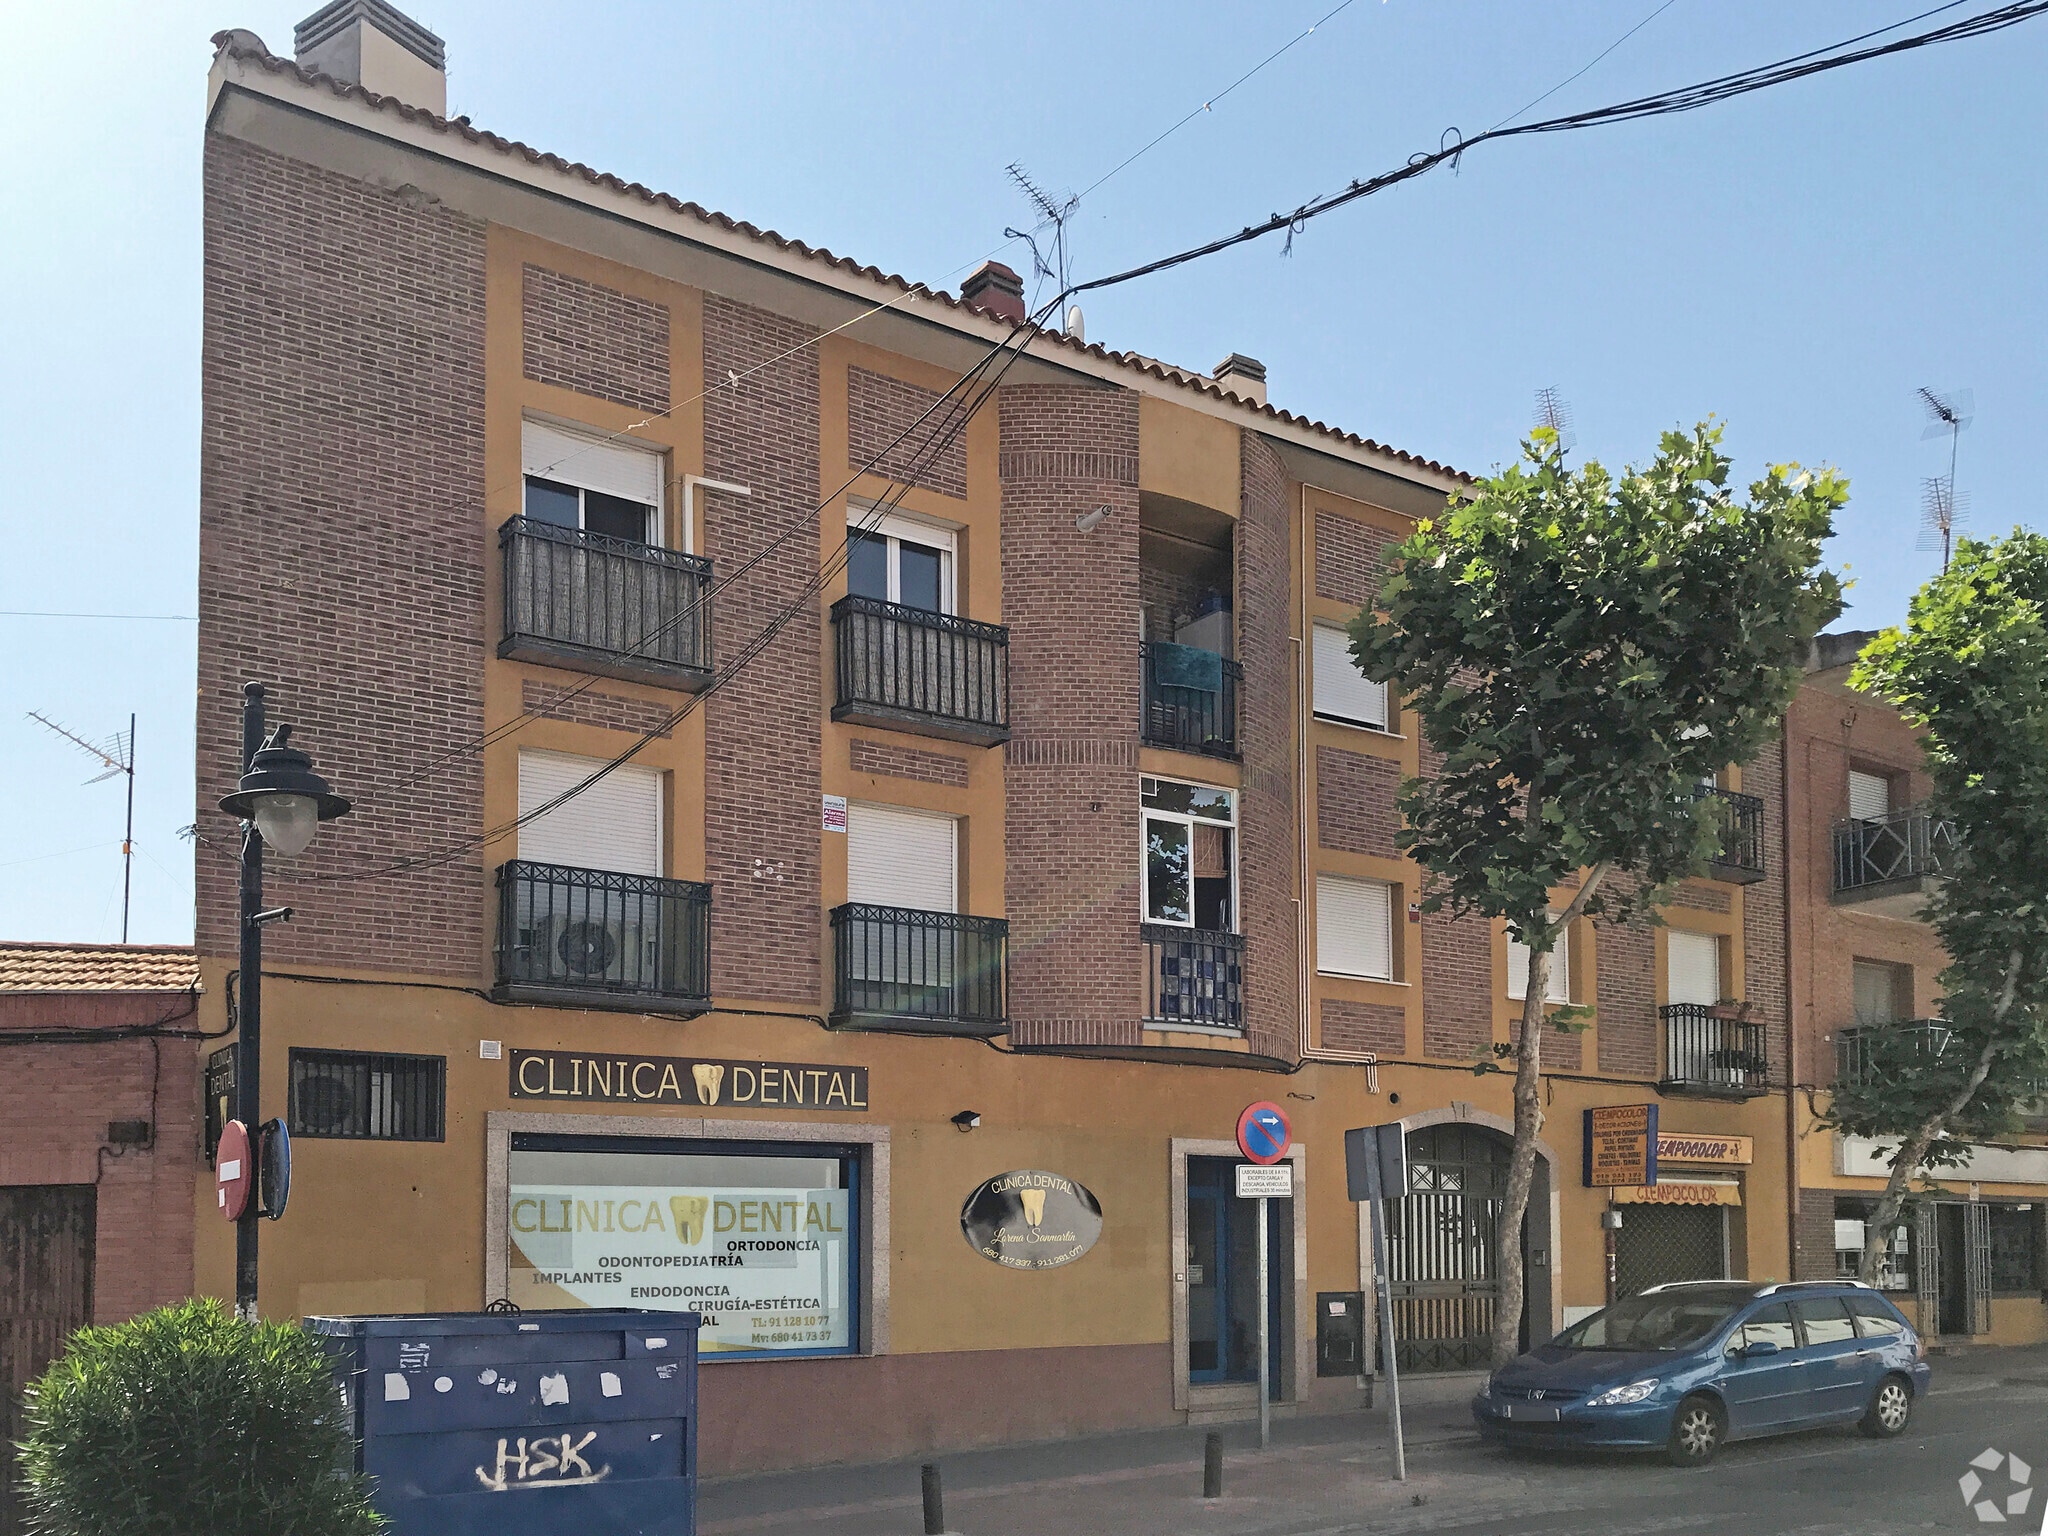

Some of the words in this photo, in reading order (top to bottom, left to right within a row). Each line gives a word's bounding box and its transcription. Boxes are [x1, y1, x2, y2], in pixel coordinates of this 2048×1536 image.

[210, 1070, 236, 1095] DENTAL
[518, 1056, 682, 1100] CLINICA
[732, 1066, 867, 1107] DENTAL
[1594, 1108, 1647, 1120] CIEMPOCOLOR
[1657, 1141, 1727, 1158] EMPOCOLOR
[991, 1175, 1032, 1194] CLINICA
[1034, 1175, 1072, 1195] DENTAL
[1636, 1185, 1718, 1201] CIEMPOCOLOR
[511, 1199, 666, 1233] CLINICA
[713, 1200, 843, 1233] DENTAL
[991, 1227, 1024, 1247] Lorena
[1027, 1227, 1076, 1243] Sanmartín
[726, 1240, 820, 1252] ORTODONCIA
[598, 1253, 744, 1268] ODONTOPEDIATRÍA
[982, 1246, 999, 1258] 680
[999, 1255, 1015, 1264] 417
[1037, 1259, 1053, 1267] 911
[1054, 1253, 1070, 1263] 281
[532, 1272, 622, 1285] IMPLANTES
[630, 1286, 730, 1298] ENDODONCIA
[688, 1296, 820, 1312] CIRUGÍA-ESTÉTICA
[701, 1316, 719, 1327] AL
[769, 1317, 781, 1327] 91
[785, 1316, 802, 1326] 128
[804, 1316, 816, 1326] 10
[818, 1315, 830, 1326] 77
[771, 1332, 789, 1343] 680
[791, 1332, 803, 1342] 41
[805, 1331, 817, 1341] 73
[819, 1330, 832, 1341] 37
[497, 1431, 597, 1480] HSK
